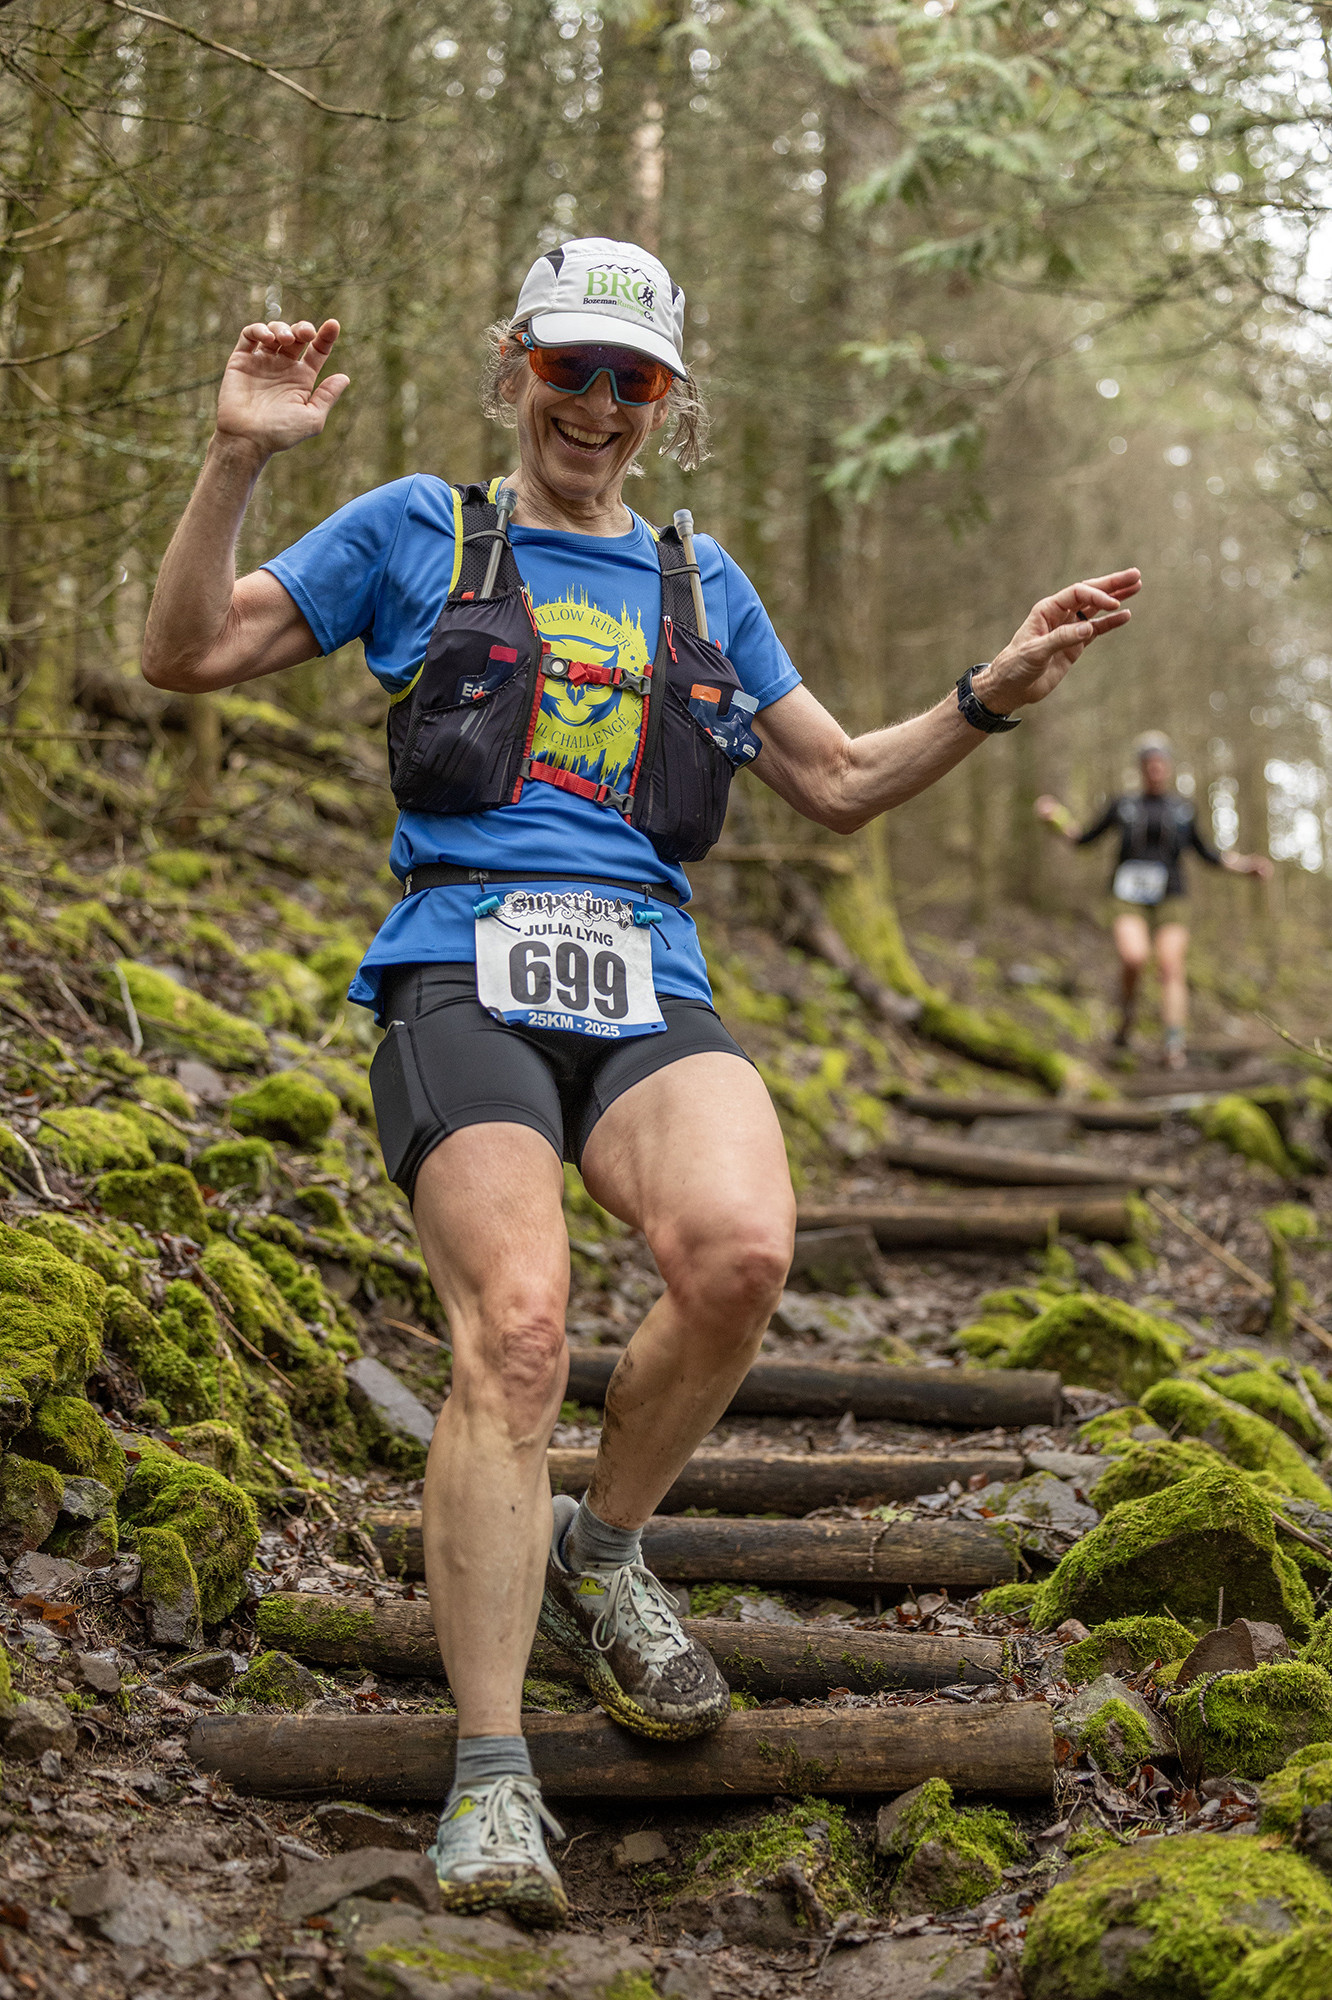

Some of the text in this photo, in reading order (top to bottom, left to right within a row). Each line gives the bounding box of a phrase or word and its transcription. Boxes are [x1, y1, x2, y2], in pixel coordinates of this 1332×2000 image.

[535, 608, 631, 650] ILLOW RIVER
[551, 713, 630, 749] CHALLENGE
[508, 890, 617, 920] Superior
[524, 923, 613, 946] JULIA LYNG
[509, 941, 629, 1019] 699
[528, 1011, 575, 1030] 25KM
[584, 1020, 620, 1037] 2025
